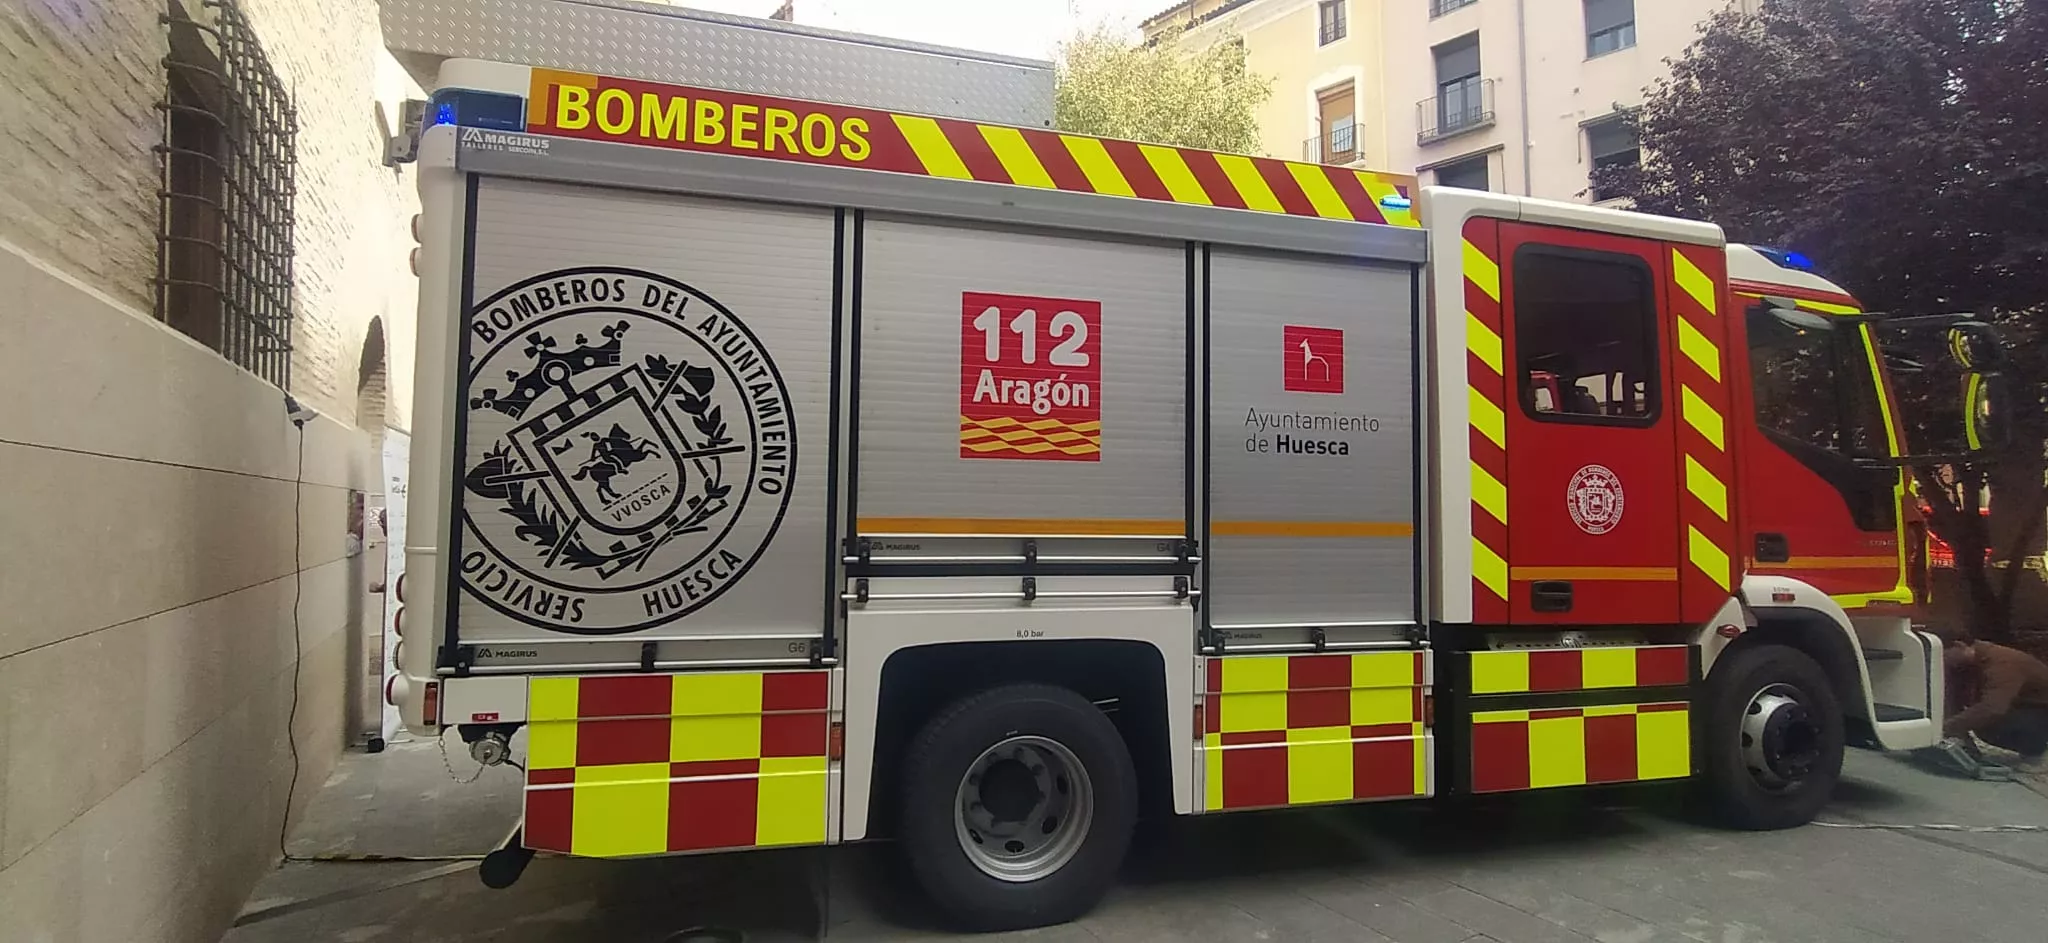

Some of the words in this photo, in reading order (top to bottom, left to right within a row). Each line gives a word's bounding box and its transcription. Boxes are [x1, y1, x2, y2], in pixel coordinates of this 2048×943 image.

[484, 133, 550, 149] MAGIRUS
[556, 84, 871, 161] BOMBEROS
[973, 305, 1090, 367] 112
[472, 277, 626, 344] BOMBEROS
[641, 283, 689, 321] DEL
[696, 314, 787, 496] AYUNTAMIENTO
[972, 368, 1090, 415] Aragón
[1245, 407, 1380, 432] Ayuntamiento
[1245, 432, 1269, 453] de
[1276, 434, 1349, 456] Huesca
[611, 484, 671, 522] VVOSCA
[461, 551, 586, 623] SERVICIO
[641, 548, 744, 618] HUESCA
[495, 650, 538, 658] MAGIRUS
